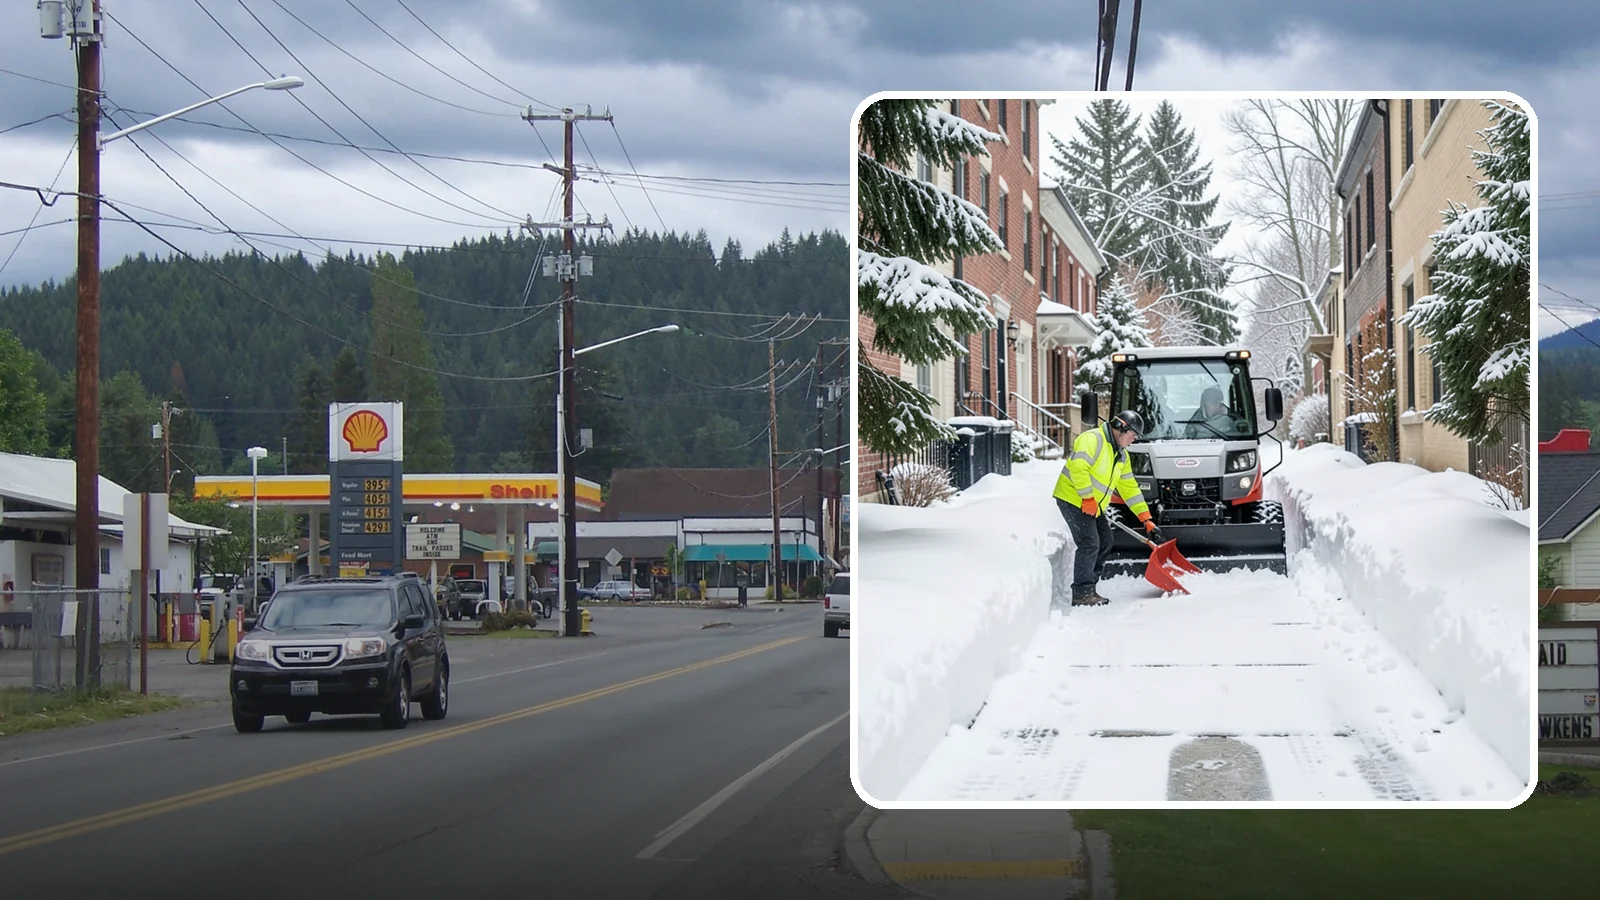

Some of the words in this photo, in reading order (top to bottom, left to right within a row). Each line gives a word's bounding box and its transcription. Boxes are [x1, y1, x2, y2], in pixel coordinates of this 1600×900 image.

[365, 480, 384, 490] 395
[490, 484, 547, 499] Shell
[365, 494, 384, 504] 405
[365, 508, 384, 518] 415
[365, 522, 384, 533] 429
